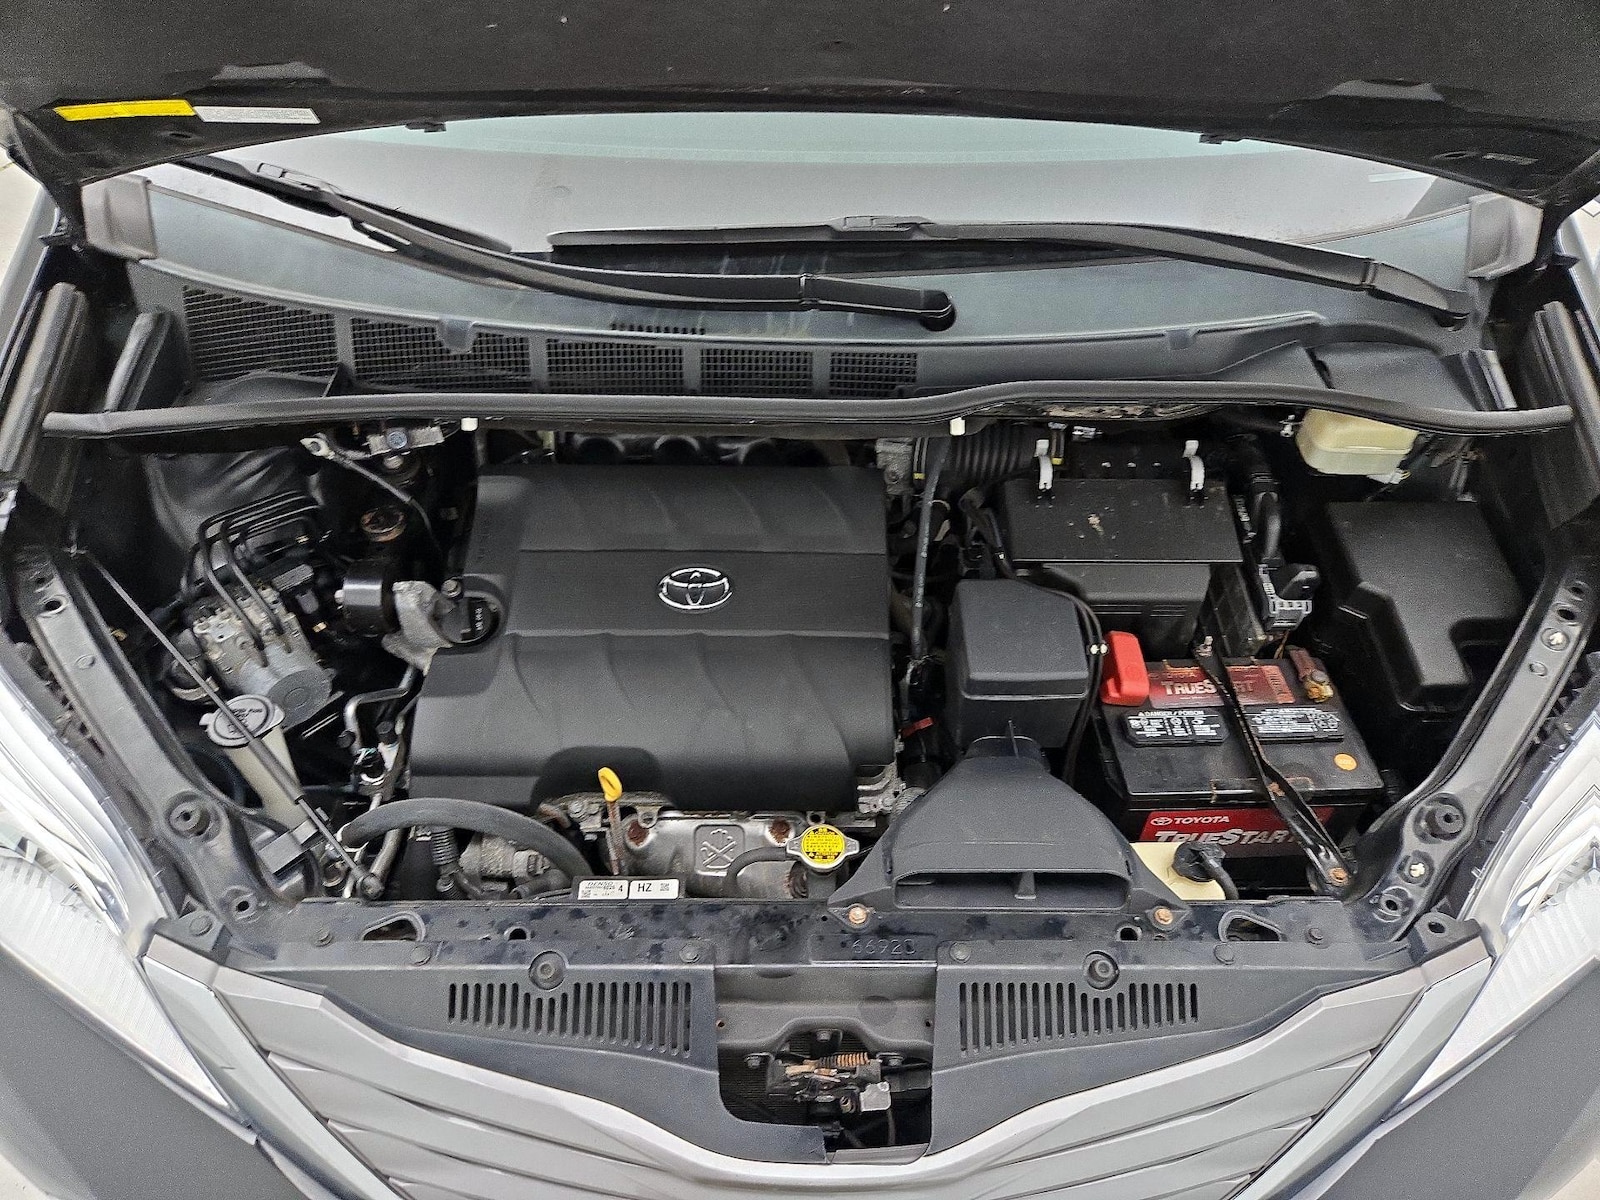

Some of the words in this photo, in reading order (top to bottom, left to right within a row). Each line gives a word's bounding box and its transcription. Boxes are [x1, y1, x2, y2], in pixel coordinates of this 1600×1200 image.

[1174, 816, 1230, 825] TOYOTA
[1154, 828, 1296, 845] TRUESTAR
[637, 883, 652, 892] HZ
